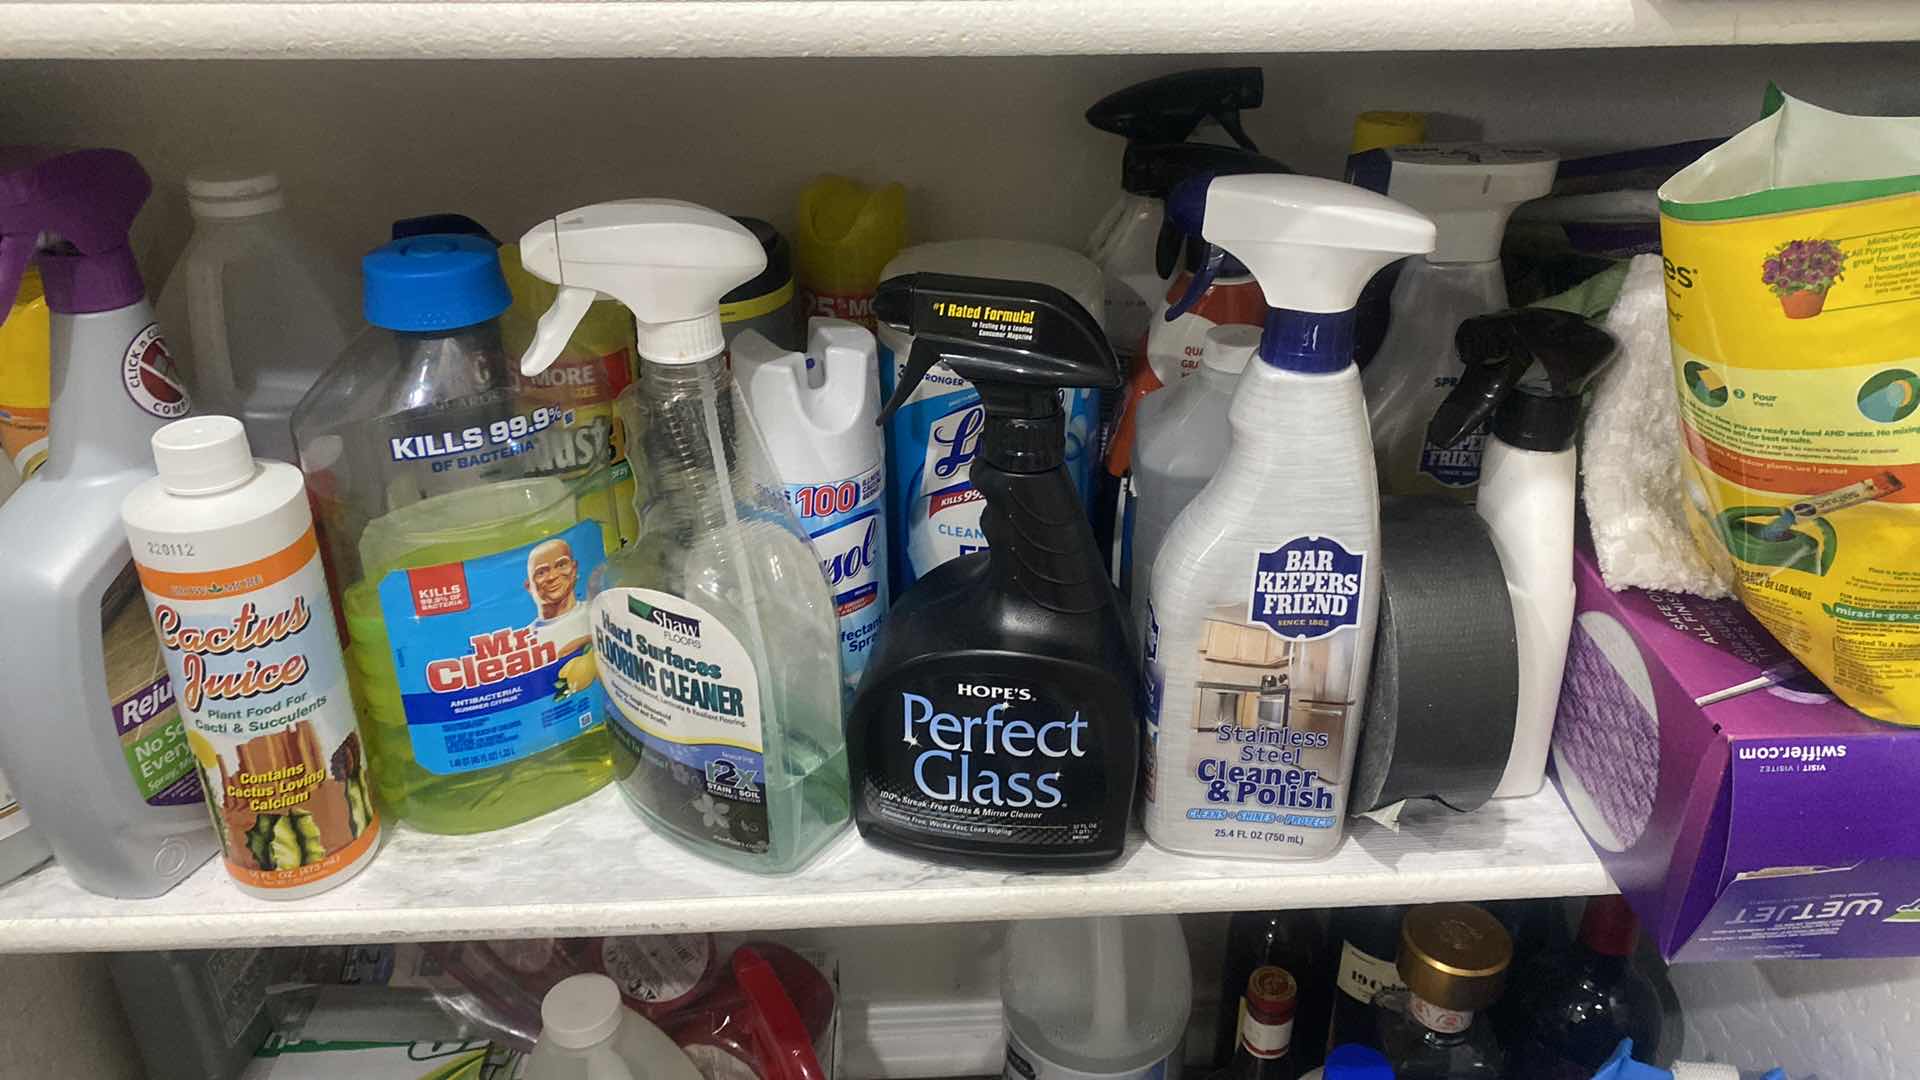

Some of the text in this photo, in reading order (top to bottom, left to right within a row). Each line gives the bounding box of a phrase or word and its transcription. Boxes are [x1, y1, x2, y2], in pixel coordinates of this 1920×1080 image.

[1663, 257, 1692, 289] es
[849, 297, 877, 317] MO
[948, 304, 981, 319] Rated
[984, 306, 1036, 324] Formula!
[127, 350, 142, 389] CLICK
[922, 372, 964, 387] TRONGER
[1434, 376, 1459, 388] SPR
[1752, 391, 1777, 401] Pour
[391, 405, 561, 462] KILLS 99.9%
[432, 443, 534, 474] OF BACTERIA
[1427, 450, 1482, 467] FRIEN
[795, 480, 861, 519] 100
[941, 495, 963, 507] KILLS
[147, 541, 196, 557] 220112
[1285, 550, 1335, 572] BAR
[418, 584, 462, 600] KILLS
[1256, 571, 1359, 596] KEEPERS
[1775, 583, 1789, 594] LOS
[1790, 586, 1813, 601] NIÑOS
[421, 599, 464, 611] BACTERIA
[1262, 593, 1348, 616] FRIEND
[1836, 605, 1920, 621] miracle-gro.c
[155, 595, 311, 656] Cactus
[653, 608, 699, 638] Shaw
[841, 614, 883, 642] fectant
[1278, 619, 1307, 627] SINCE
[1657, 604, 1689, 631] SAFE
[470, 626, 538, 660] Mr.
[601, 609, 723, 680] Hard Surfaces
[664, 630, 702, 649] FLOORS
[849, 634, 876, 653] Spr
[1693, 625, 1720, 646] ALL
[426, 640, 559, 694] Clean
[595, 623, 657, 692] FLOORING
[659, 667, 745, 718] CLEANER
[183, 652, 310, 712] Juice
[957, 683, 1032, 701] HOPE'S
[121, 681, 173, 726] Reju
[208, 692, 308, 721] Plant Food For
[450, 686, 524, 708] ANTIBACTERIAL
[454, 702, 490, 714] SUMMER
[196, 695, 328, 735] Cacti & Succulents
[902, 692, 1089, 758] Perfect
[1217, 724, 1329, 748] Stainless
[135, 738, 163, 763] No
[1240, 745, 1303, 764] Steel
[1738, 743, 1847, 762] swiffer.com
[240, 762, 306, 785] Contains
[914, 749, 1063, 808] Glass
[1197, 759, 1318, 788] Cleaner
[1802, 763, 1826, 771] VISIT
[227, 782, 275, 799] Cactus
[279, 767, 326, 794] Loving
[707, 782, 760, 799] STAIN SOIL
[1207, 780, 1333, 809] & Polish
[249, 790, 310, 813] Calcium
[902, 796, 949, 813] Streak-Free
[949, 804, 973, 816] Glass
[973, 807, 980, 816] &
[981, 808, 1009, 819] Mirror
[1010, 809, 1043, 820] Cleaner
[1214, 828, 1234, 838] 25.4
[1250, 830, 1263, 840] OZ
[1264, 831, 1285, 843] (750
[1287, 834, 1304, 845] mL)
[1723, 898, 1882, 925] WETJET
